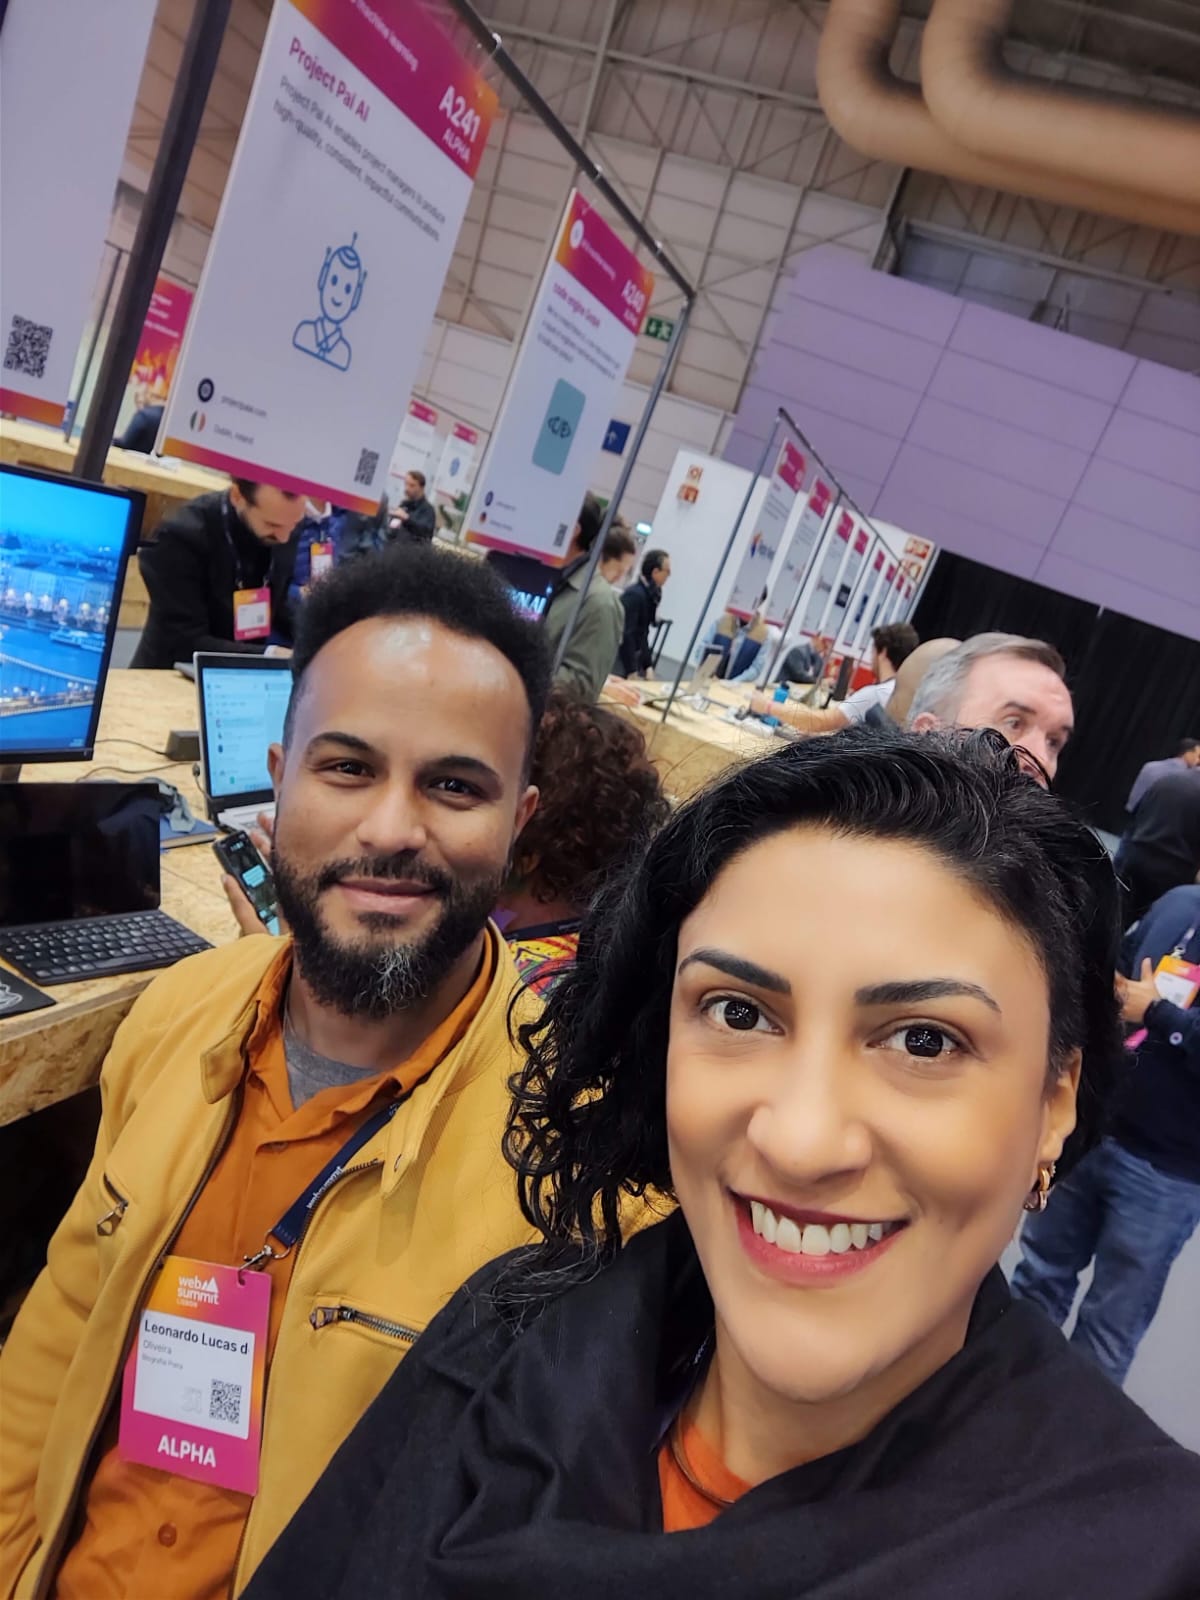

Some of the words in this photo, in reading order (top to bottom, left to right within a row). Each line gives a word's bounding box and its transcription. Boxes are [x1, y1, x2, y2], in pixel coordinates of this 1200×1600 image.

[289, 37, 336, 93] Project
[335, 80, 357, 110] Pal
[355, 100, 371, 122] AI
[280, 75, 311, 111] Project
[310, 101, 324, 121] Pal
[323, 114, 334, 129] AI
[438, 85, 481, 143] A241
[440, 127, 472, 163] ALPHA
[177, 1287, 220, 1305] summit
[178, 1275, 202, 1290] web
[142, 1340, 172, 1355] Oliveira
[144, 1319, 199, 1344] Leonardo
[201, 1332, 238, 1353] Lucas
[157, 1434, 217, 1468] ALPHA
